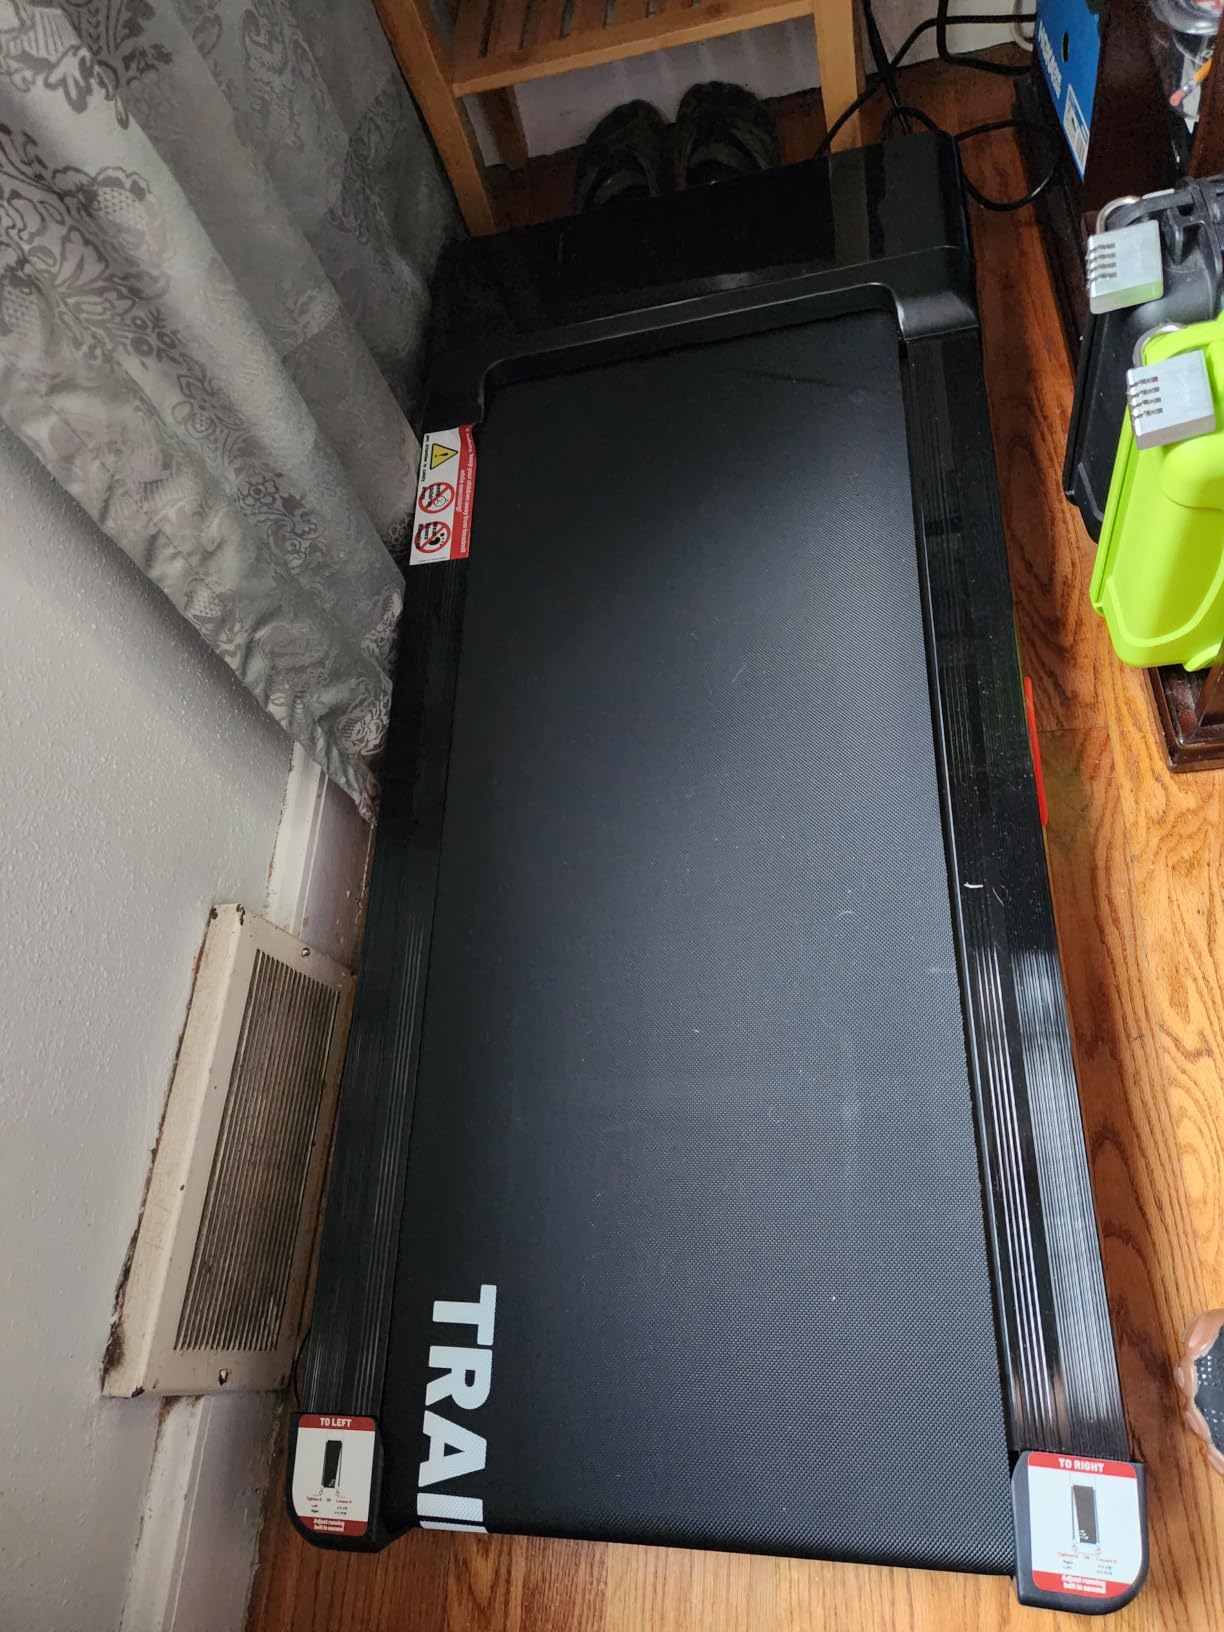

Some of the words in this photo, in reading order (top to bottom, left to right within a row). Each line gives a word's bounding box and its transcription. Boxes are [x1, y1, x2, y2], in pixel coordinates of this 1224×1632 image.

[320, 1417, 331, 1426] TO
[331, 1418, 352, 1427] LEFT
[1058, 1458, 1072, 1469] TO
[1073, 1460, 1104, 1473] RIGHT
